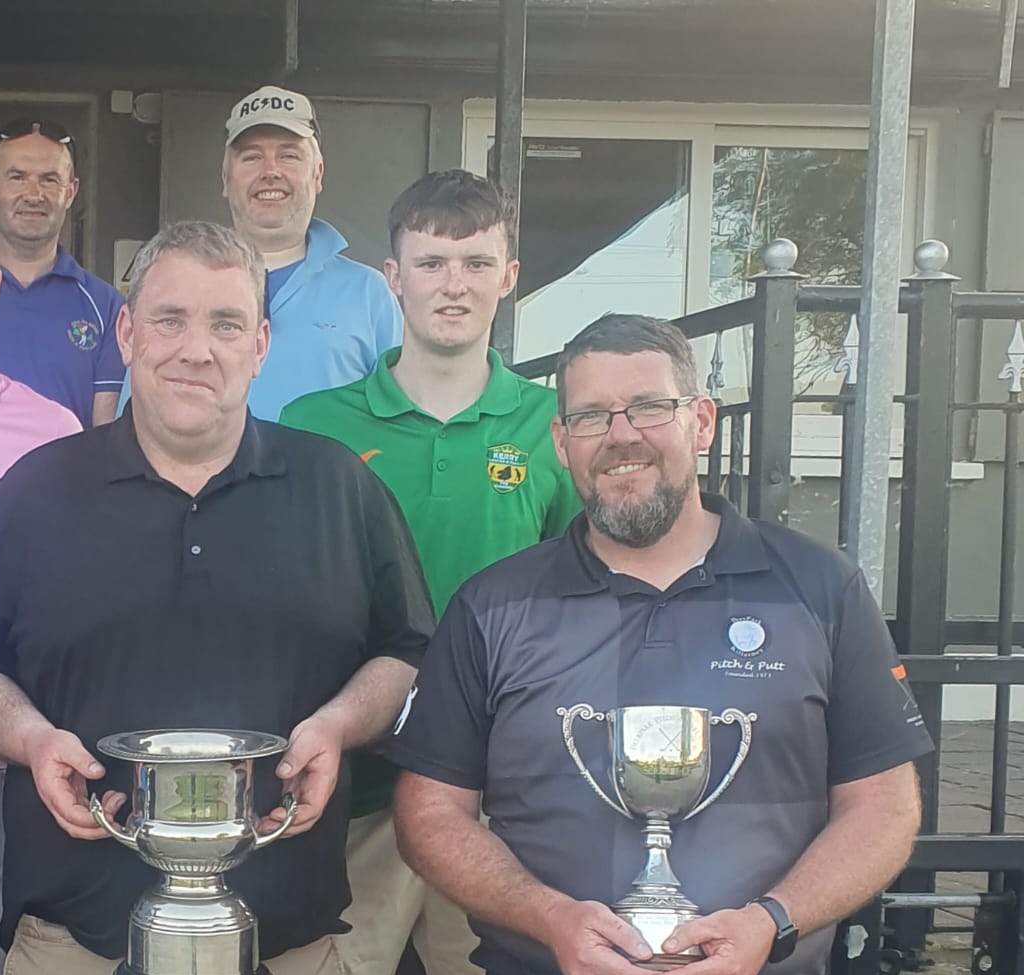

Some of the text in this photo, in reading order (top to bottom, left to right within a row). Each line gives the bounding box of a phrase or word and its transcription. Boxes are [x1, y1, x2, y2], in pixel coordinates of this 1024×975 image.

[710, 659, 786, 671] Pitch & Putt
